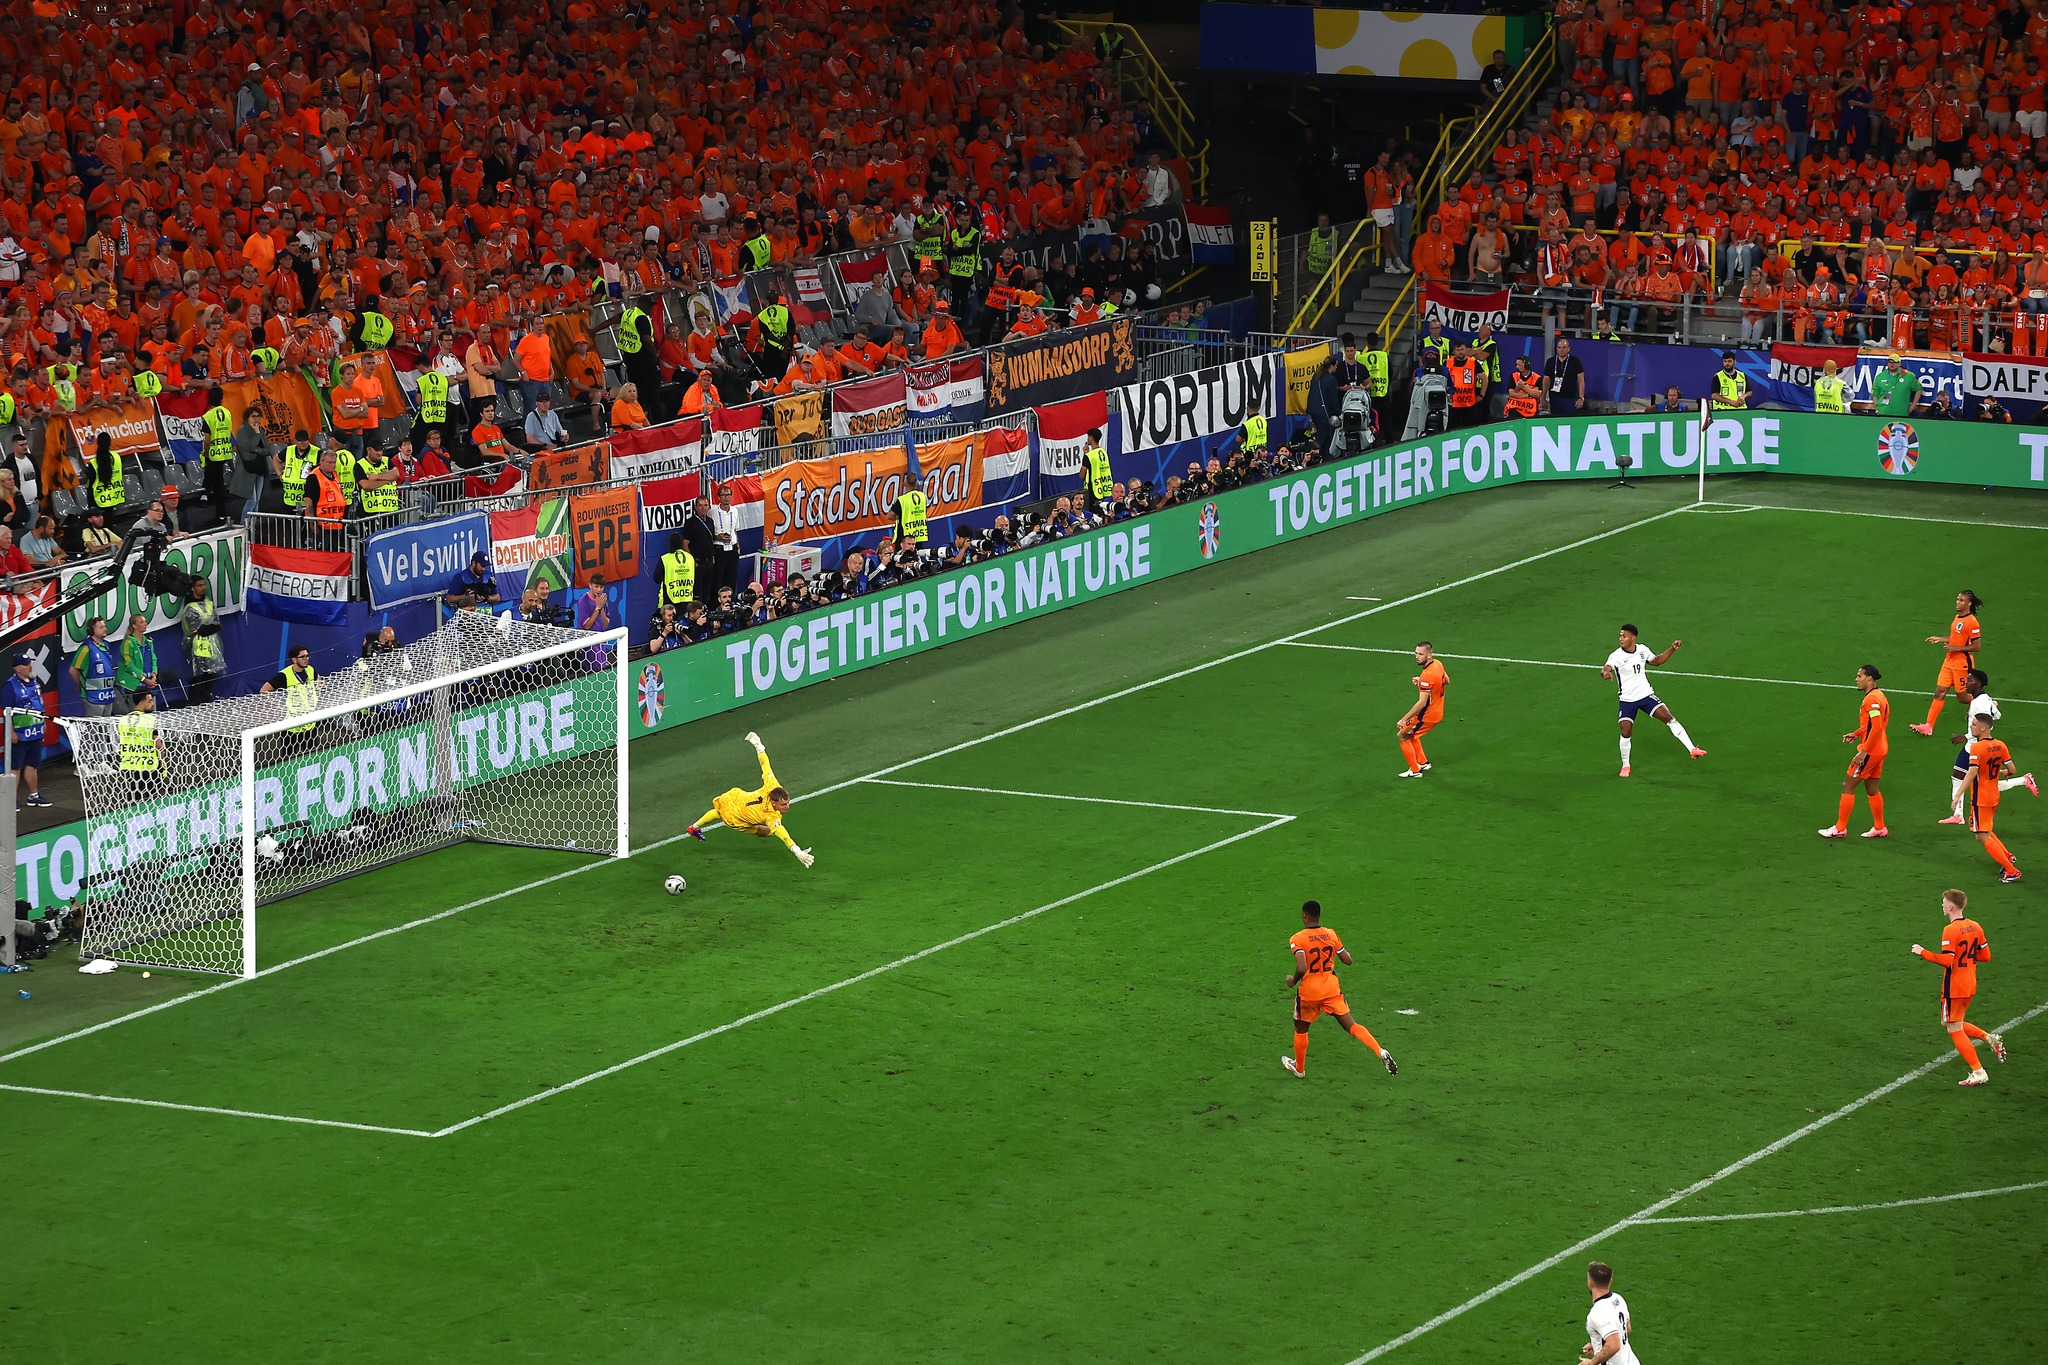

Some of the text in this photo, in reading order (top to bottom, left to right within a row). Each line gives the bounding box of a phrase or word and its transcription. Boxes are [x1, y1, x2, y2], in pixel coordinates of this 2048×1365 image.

[1253, 223, 1266, 232] 23
[1256, 243, 1263, 251] 4
[1257, 263, 1263, 271] 3
[1960, 318, 1970, 344] NOTHING
[1007, 332, 1111, 390] NUMANSDORP
[1972, 364, 2048, 396] DALF
[1122, 355, 1272, 450] VORTUM
[714, 425, 764, 454] LOCHEM
[1046, 445, 1082, 469] VENR
[561, 472, 578, 485] goes
[773, 443, 974, 536] Stadskaaal
[1269, 418, 1780, 537] TOGETHER FOR NATURE
[576, 501, 631, 523] BOUWMEESTER
[645, 499, 695, 531] VORDE
[376, 529, 480, 586] Velswijk
[494, 532, 568, 567] DOETINCHEM
[578, 514, 633, 571] EPE
[250, 566, 338, 599] AFFERDEN
[726, 523, 1152, 698] TOGETHER FOR NATURE
[1632, 663, 1641, 675] 19
[1986, 756, 2002, 781] 16
[15, 775, 284, 909] TOGETHER
[296, 747, 389, 828] FOR
[1309, 945, 1334, 974] 22
[1958, 937, 1979, 968] 24
